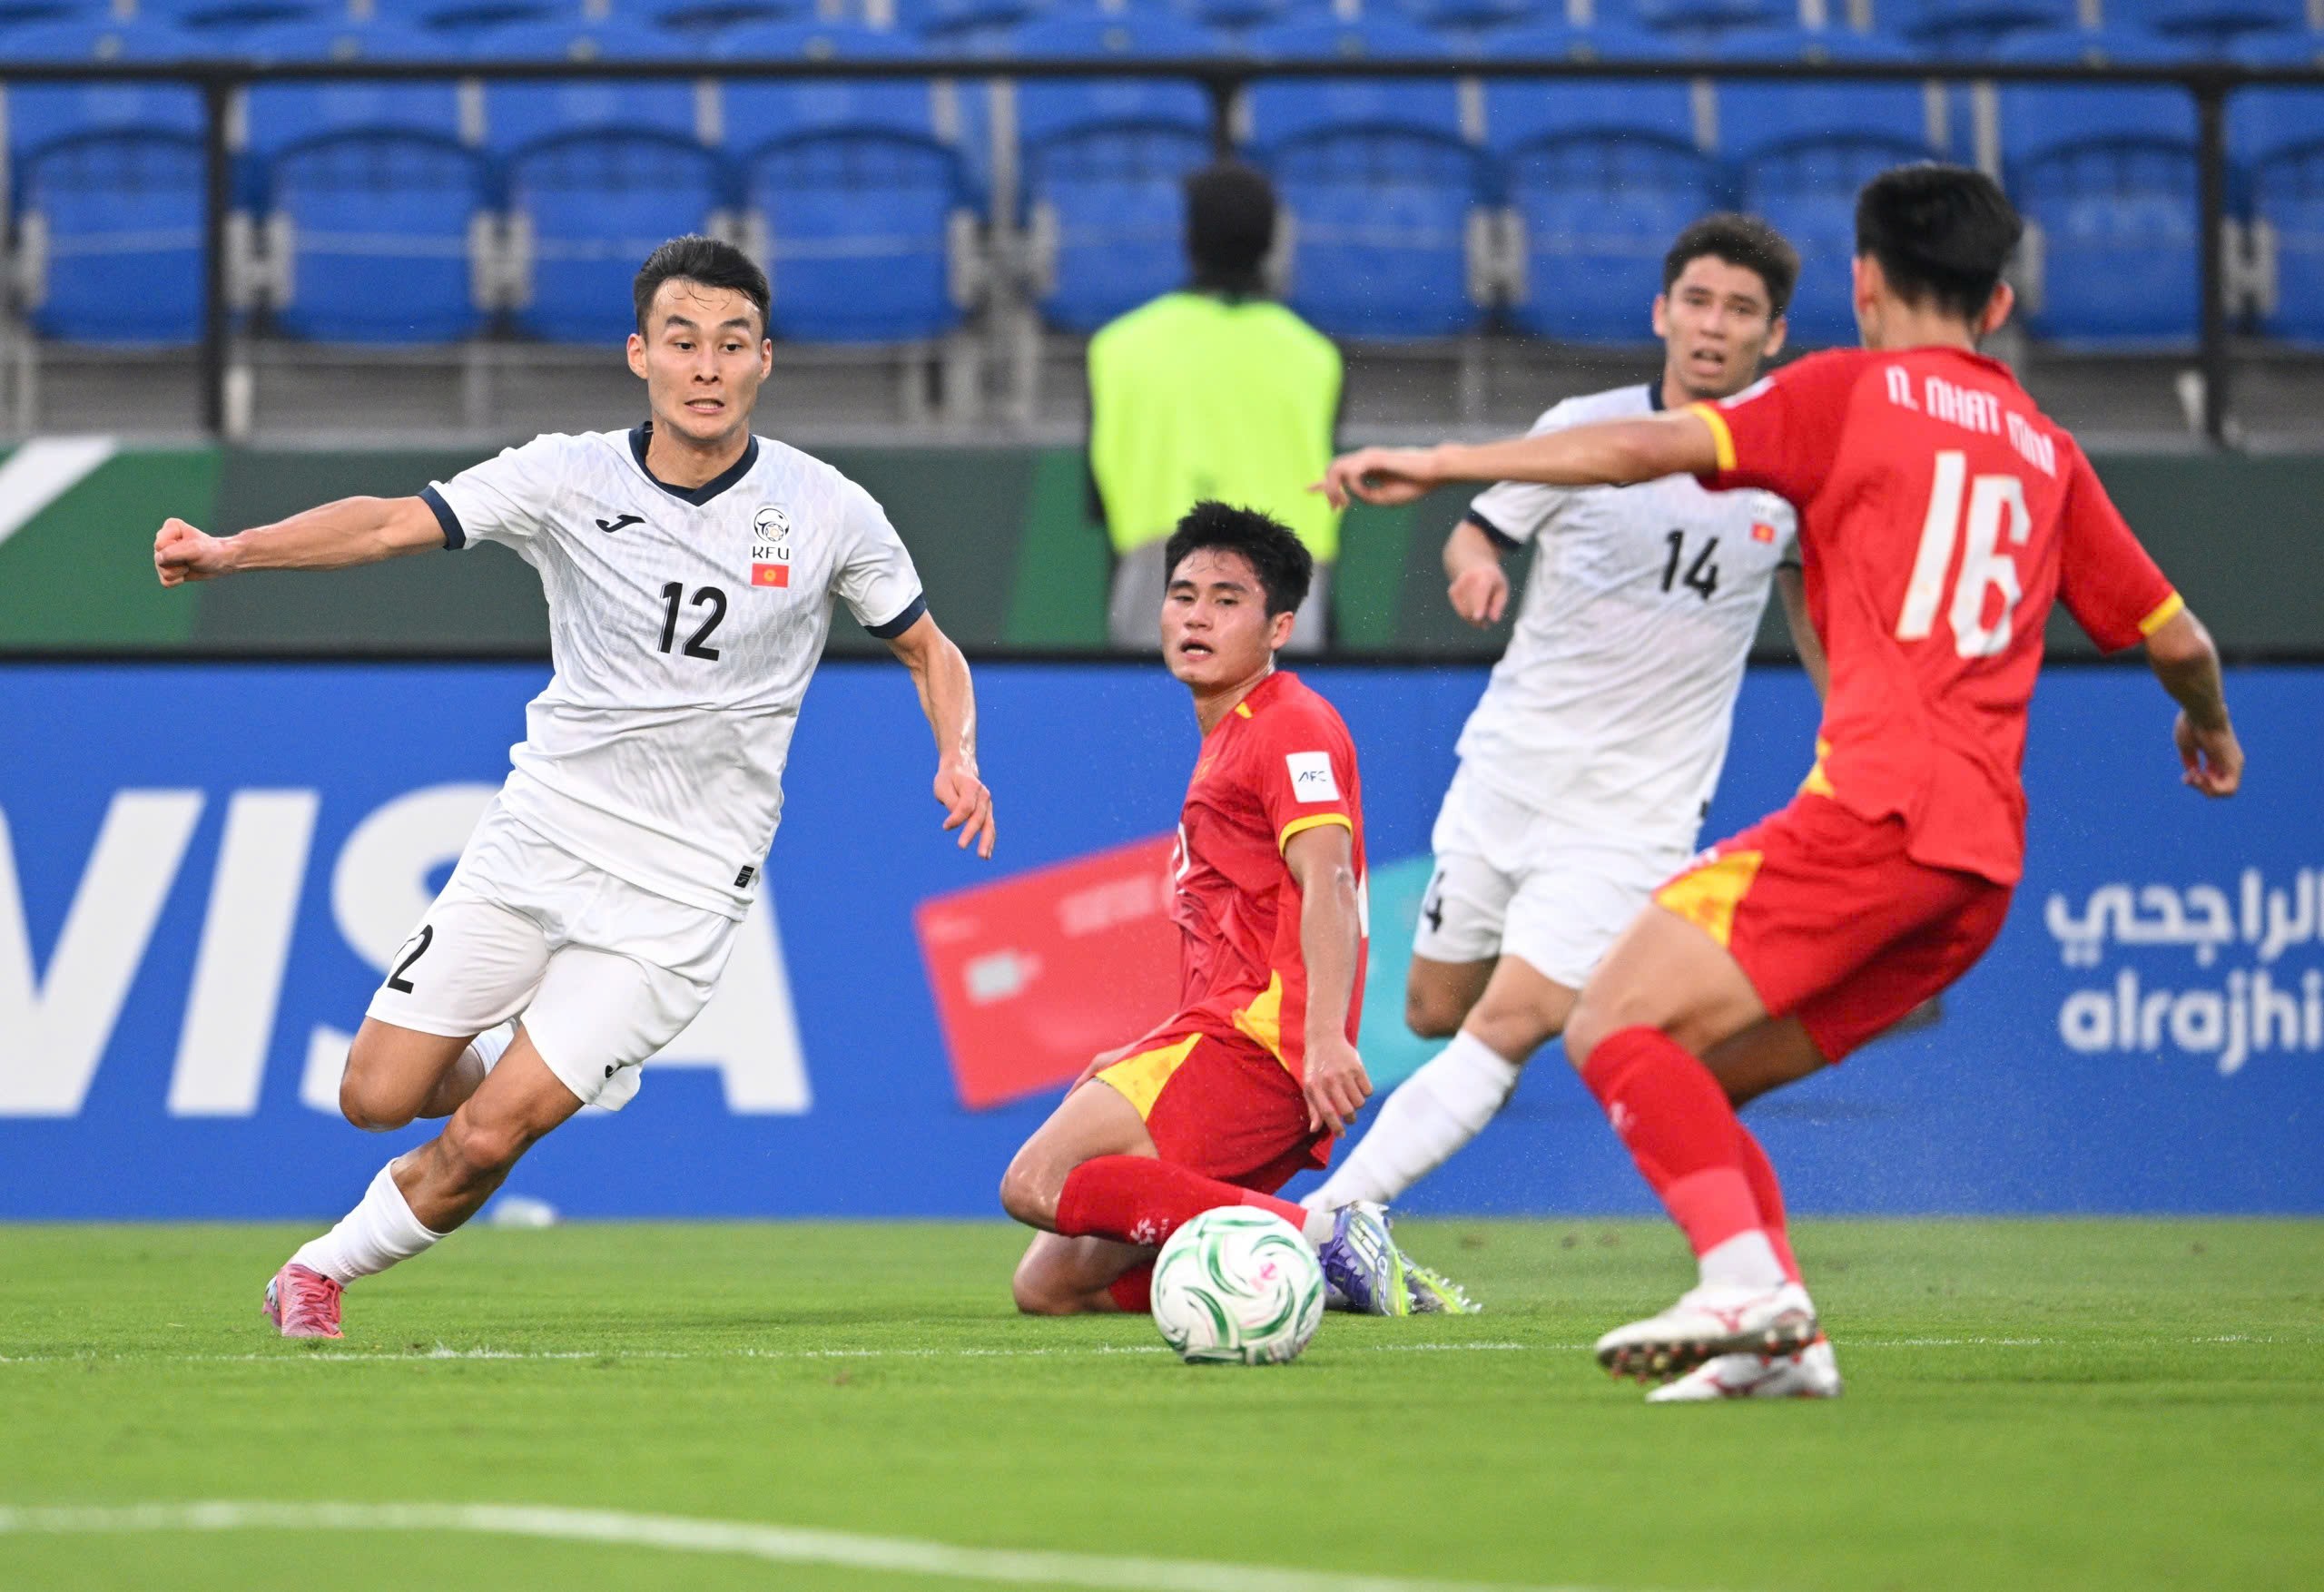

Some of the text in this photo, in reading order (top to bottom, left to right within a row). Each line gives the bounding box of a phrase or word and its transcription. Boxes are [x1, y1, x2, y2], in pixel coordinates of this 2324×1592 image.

[752, 545, 790, 561] KFU
[1660, 529, 1720, 601] 14
[1895, 450, 2033, 659] 16
[656, 581, 727, 662] 12
[1298, 771, 1326, 782] AFC
[2058, 968, 2323, 1075] alrajhi
